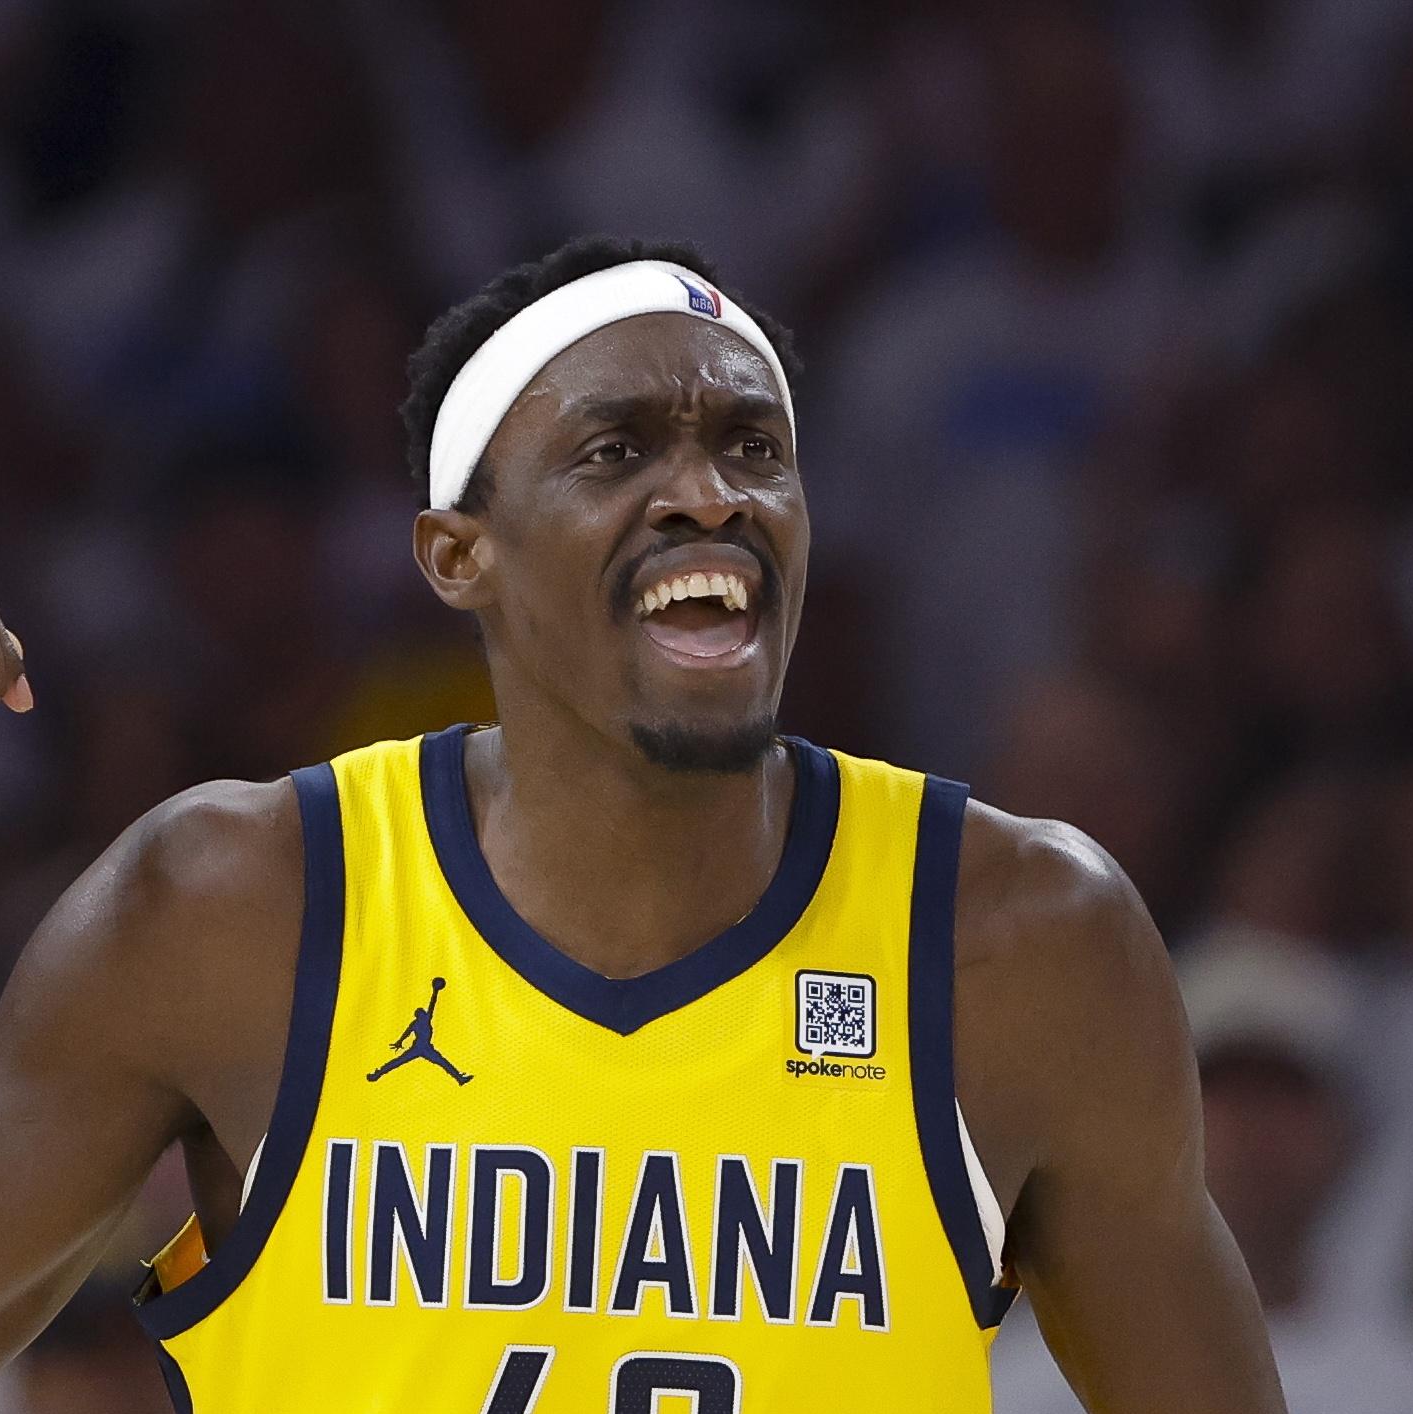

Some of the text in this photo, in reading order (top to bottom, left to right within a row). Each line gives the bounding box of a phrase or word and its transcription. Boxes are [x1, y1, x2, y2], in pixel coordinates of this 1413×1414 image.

[691, 297, 713, 312] NBA
[786, 1058, 886, 1080] spokenote
[322, 1137, 890, 1332] INDIANA
